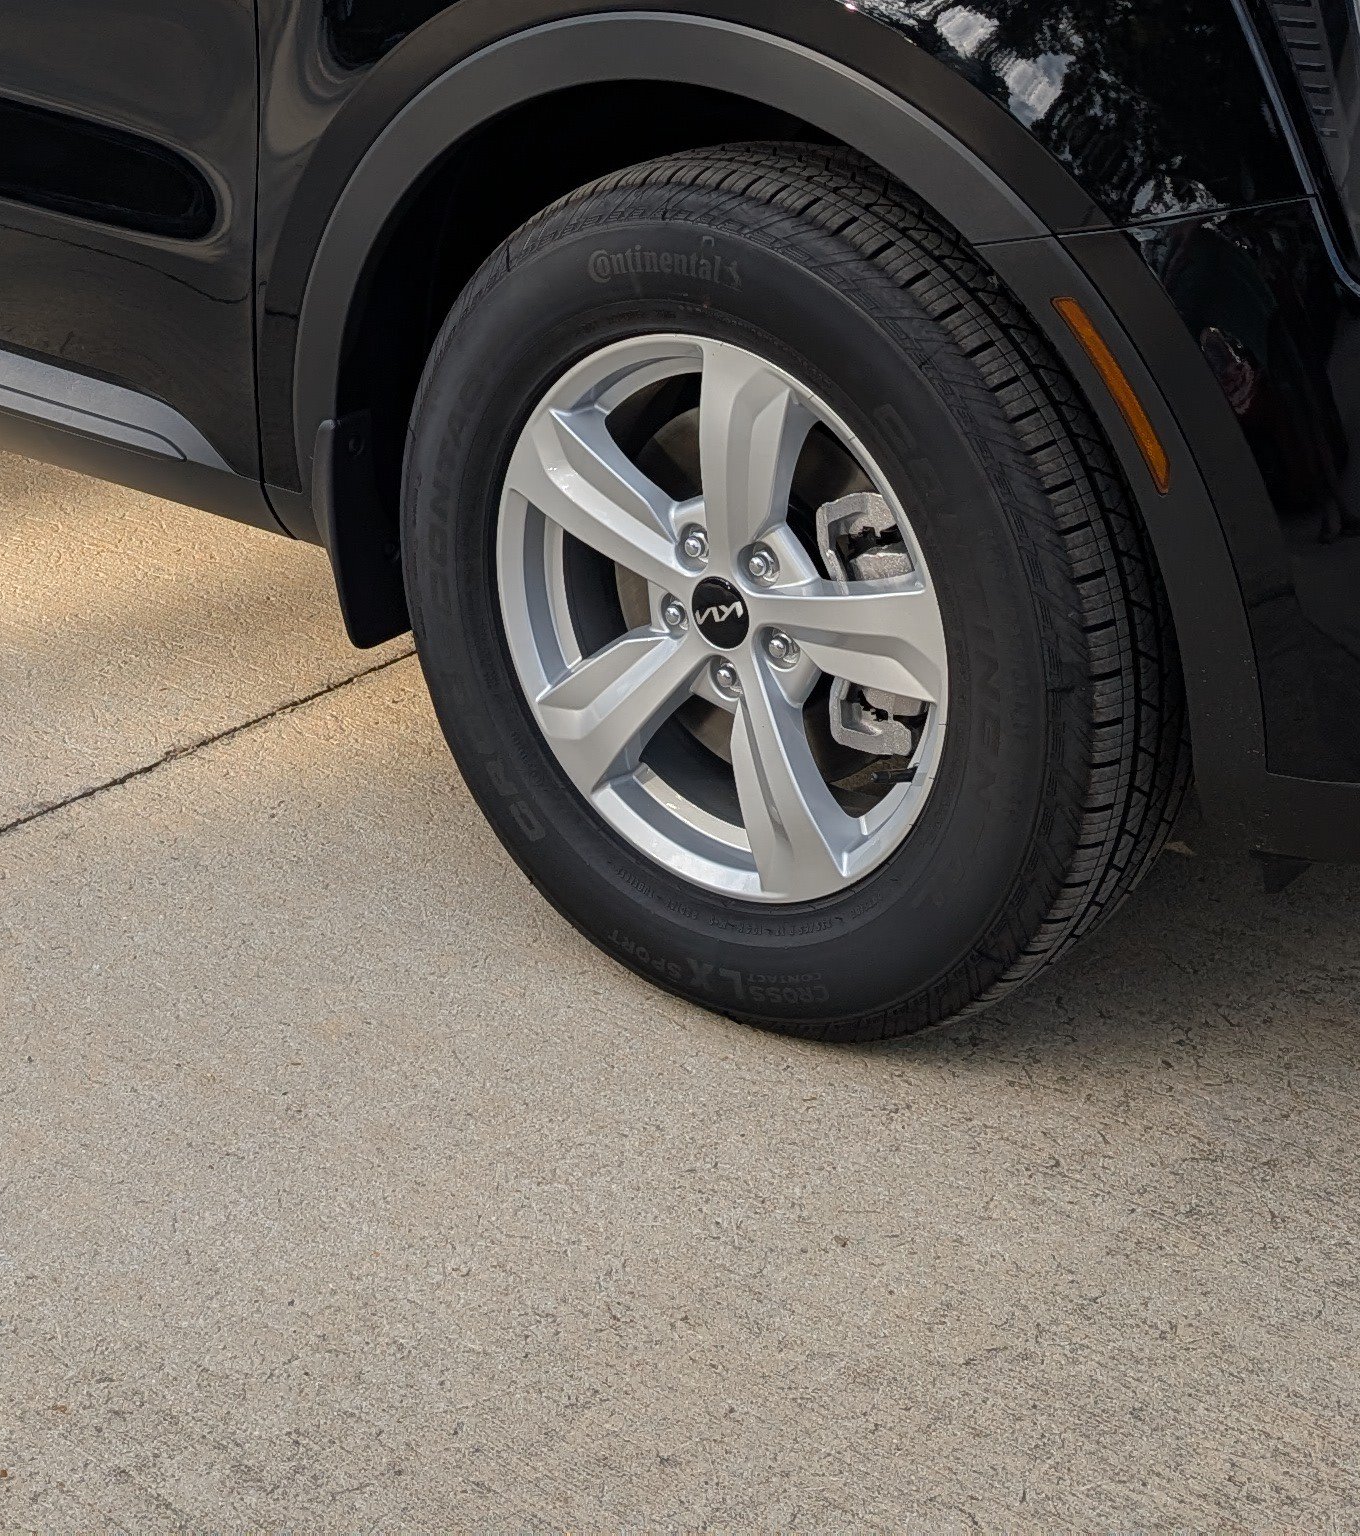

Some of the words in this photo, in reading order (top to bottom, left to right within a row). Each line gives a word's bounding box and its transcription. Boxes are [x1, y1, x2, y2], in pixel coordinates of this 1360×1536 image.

[588, 243, 721, 284] Continental
[694, 600, 744, 626] KIA
[607, 929, 683, 984] SPORT
[745, 972, 822, 984] CONTACT
[748, 984, 830, 1004] CROSS
